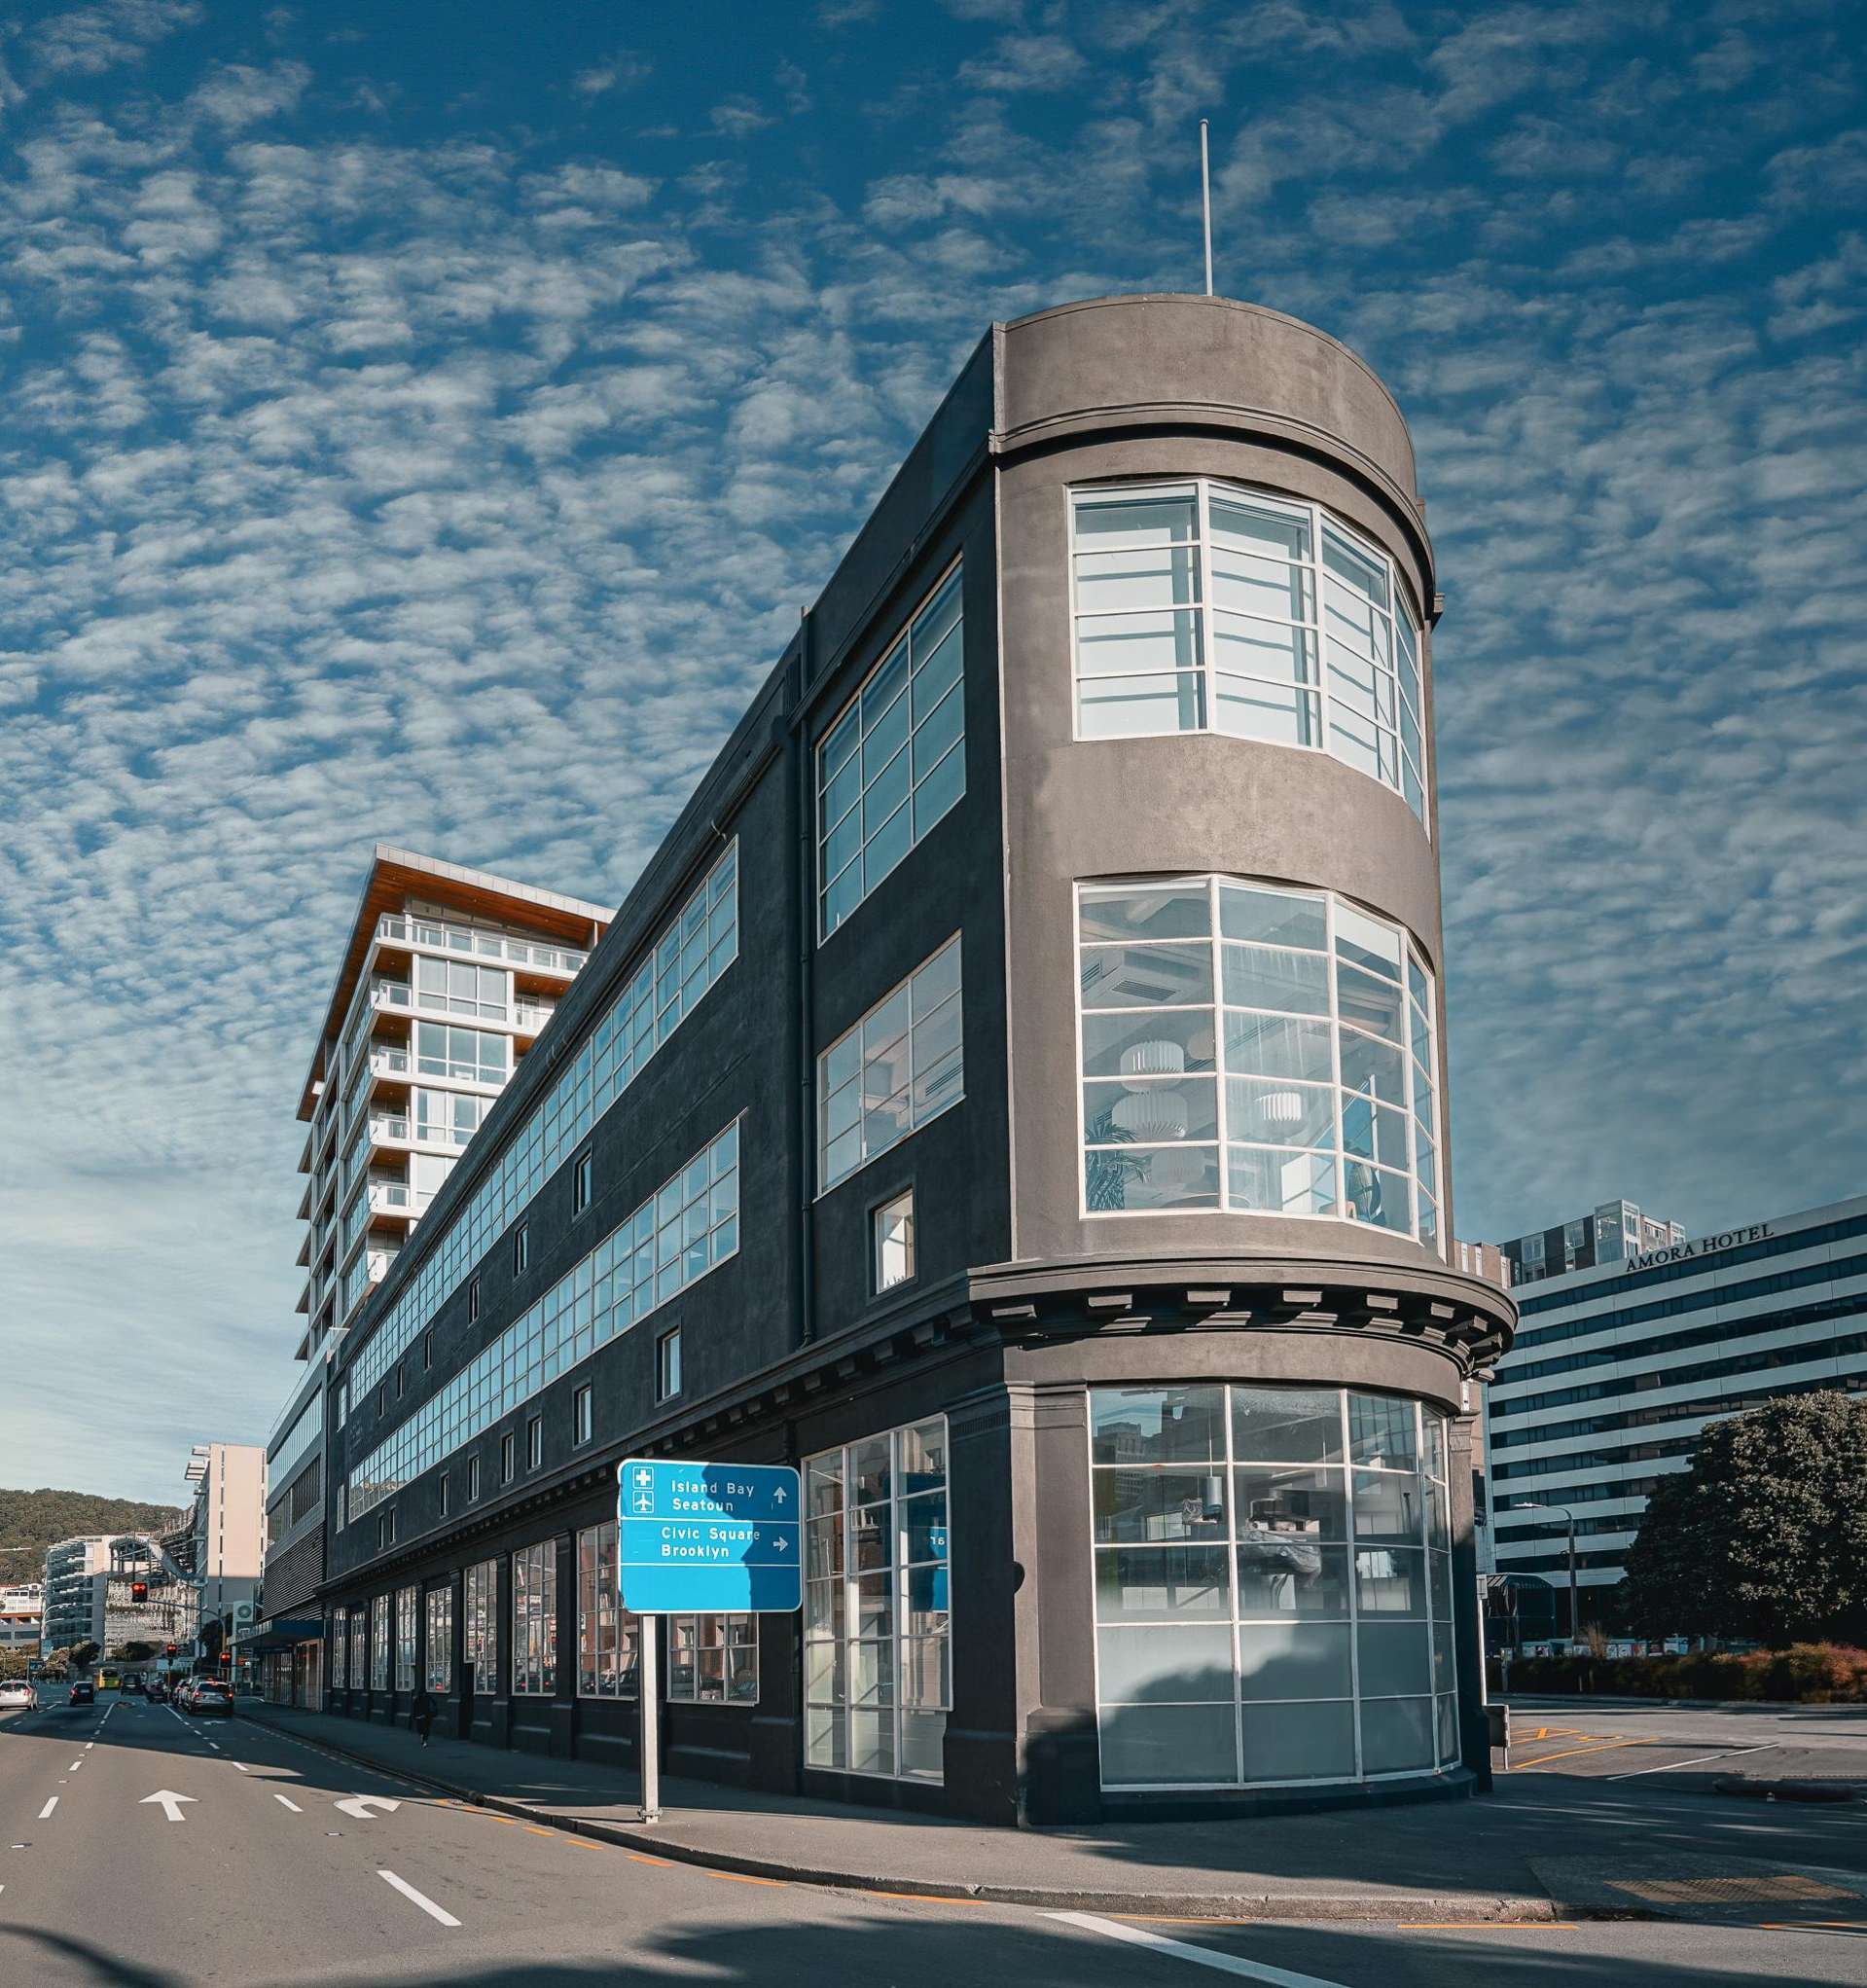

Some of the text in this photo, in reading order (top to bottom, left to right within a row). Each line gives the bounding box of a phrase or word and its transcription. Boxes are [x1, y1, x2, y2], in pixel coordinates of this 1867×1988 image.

[1626, 1223, 1774, 1272] AMORA HOTEL
[671, 1480, 754, 1497] Island Bay
[672, 1499, 734, 1511] Seatoun
[661, 1527, 760, 1542] Civic Square
[661, 1544, 730, 1560] Brooklyn
